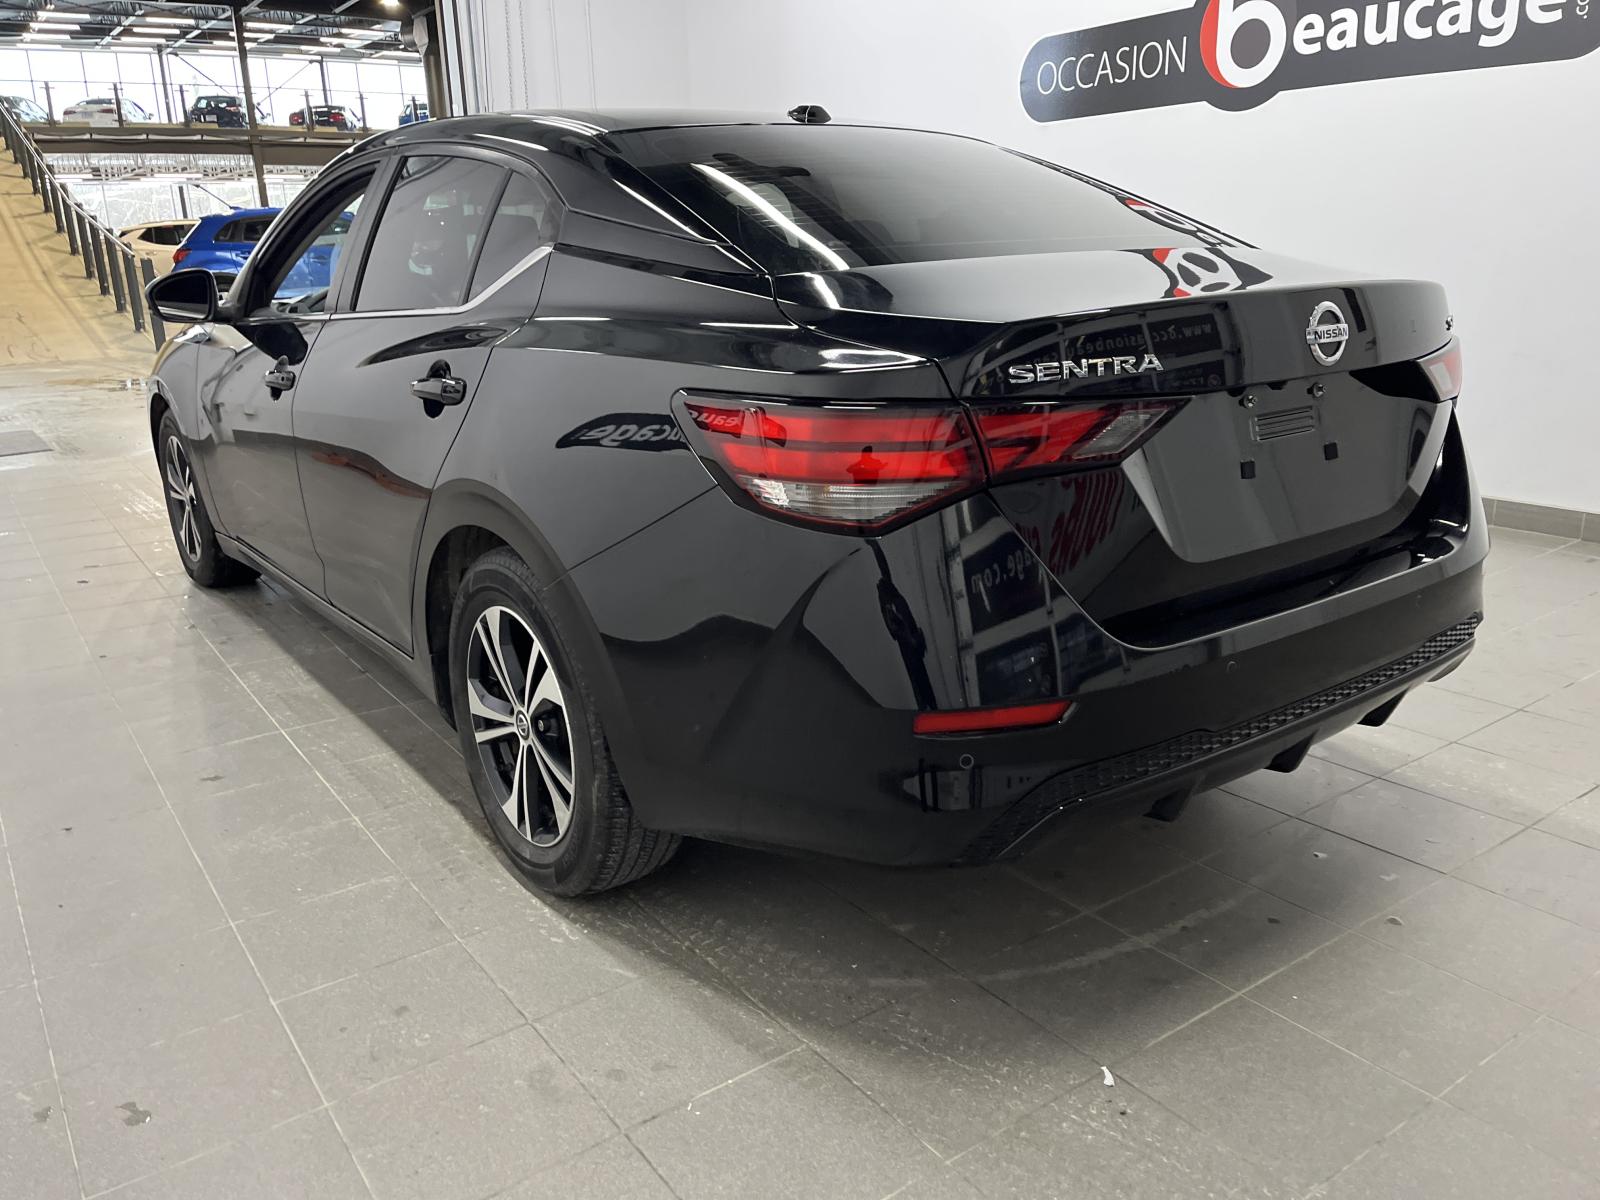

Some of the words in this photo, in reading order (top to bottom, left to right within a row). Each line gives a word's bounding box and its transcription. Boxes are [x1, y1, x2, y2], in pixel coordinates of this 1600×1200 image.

[1037, 36, 1187, 95] OCCASION
[1314, 327, 1347, 341] NISSAN
[1008, 354, 1164, 384] SENTRA
